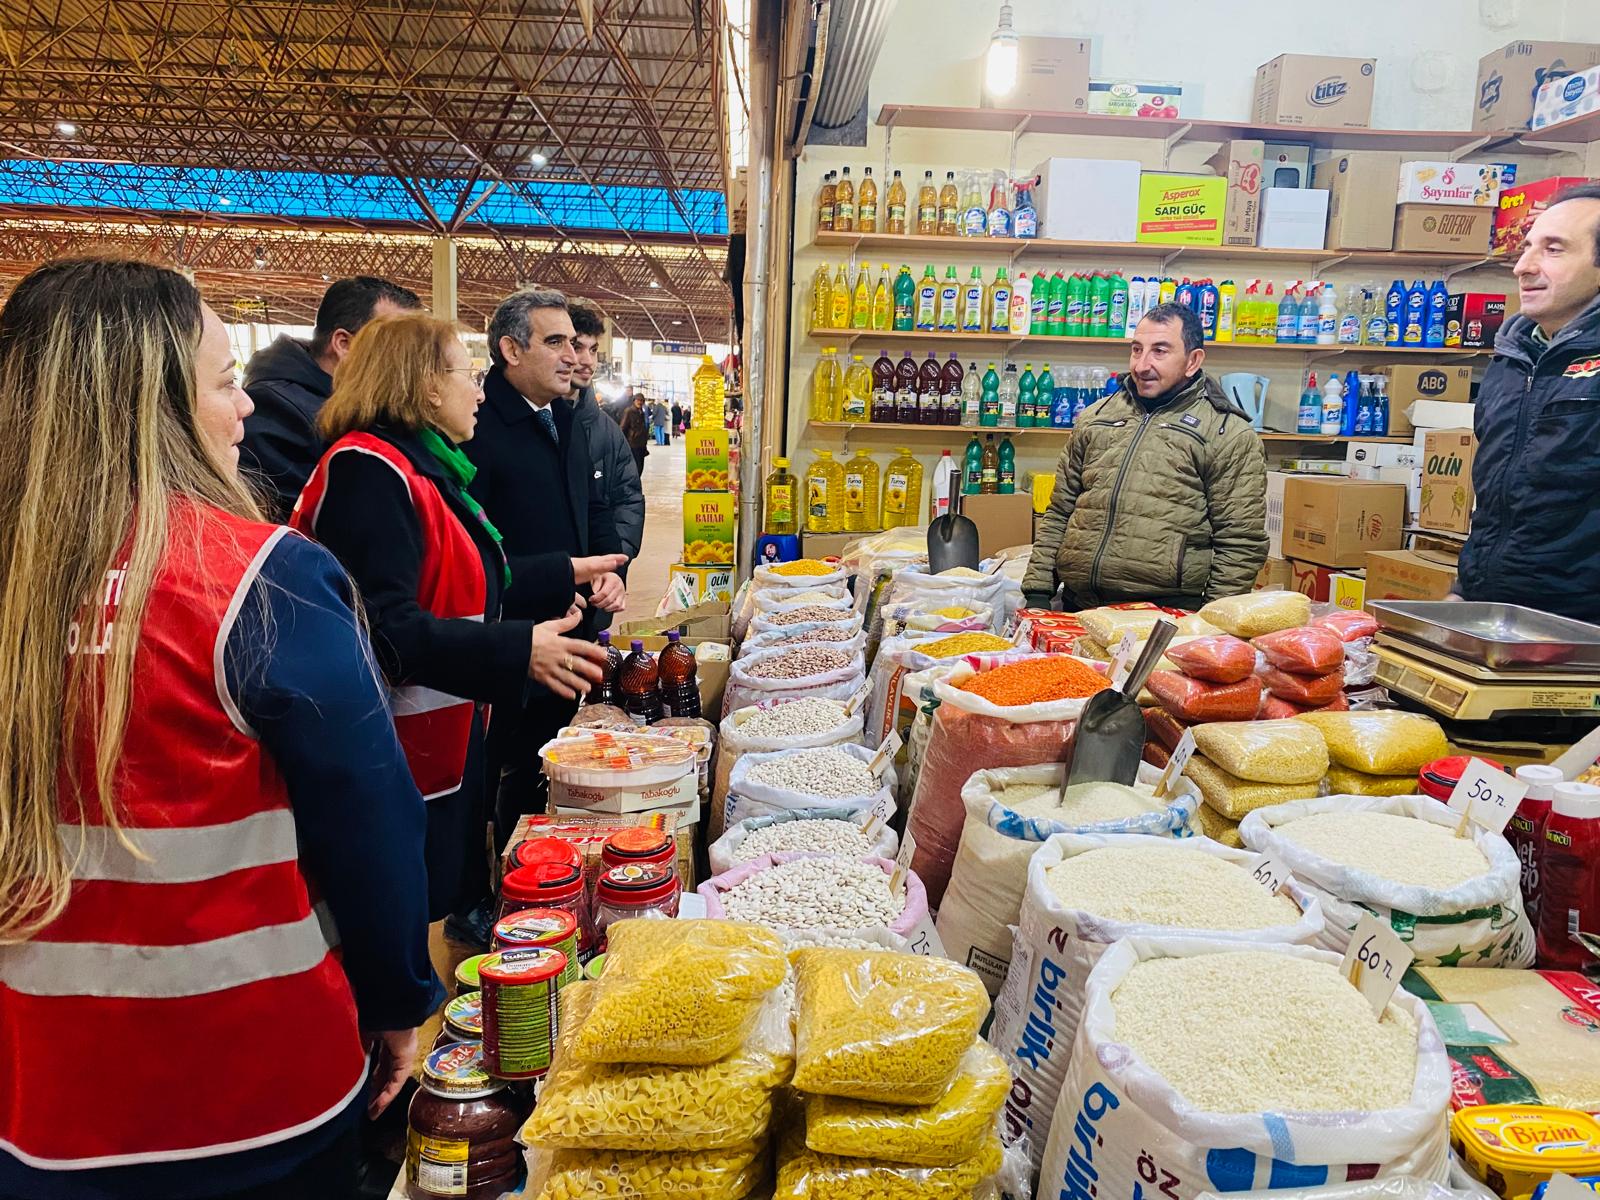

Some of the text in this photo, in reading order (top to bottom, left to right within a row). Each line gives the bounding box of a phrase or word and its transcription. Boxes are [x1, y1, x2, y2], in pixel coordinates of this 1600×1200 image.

[1314, 80, 1348, 101] titiz
[1163, 188, 1201, 201] Asperox
[1421, 185, 1473, 201] Sayınlar
[1154, 204, 1206, 216] SARI GÜÇ
[921, 290, 936, 299] ABC
[942, 291, 957, 299] ABC
[966, 291, 980, 299] ABC
[994, 292, 1009, 301] ABC
[1420, 376, 1445, 390] ABC
[1427, 452, 1462, 477] OLİN
[701, 503, 718, 513] YENİ
[695, 514, 724, 523] BAHAR
[711, 573, 729, 587] OLİN
[568, 788, 605, 803] Tabakoğlu
[640, 786, 681, 800] Tabakoğlu
[1467, 778, 1492, 801] 50
[1253, 860, 1272, 885] 60
[1358, 934, 1380, 969] 60
[1017, 957, 1066, 1069] birlik
[1510, 1123, 1585, 1144] Bizim
